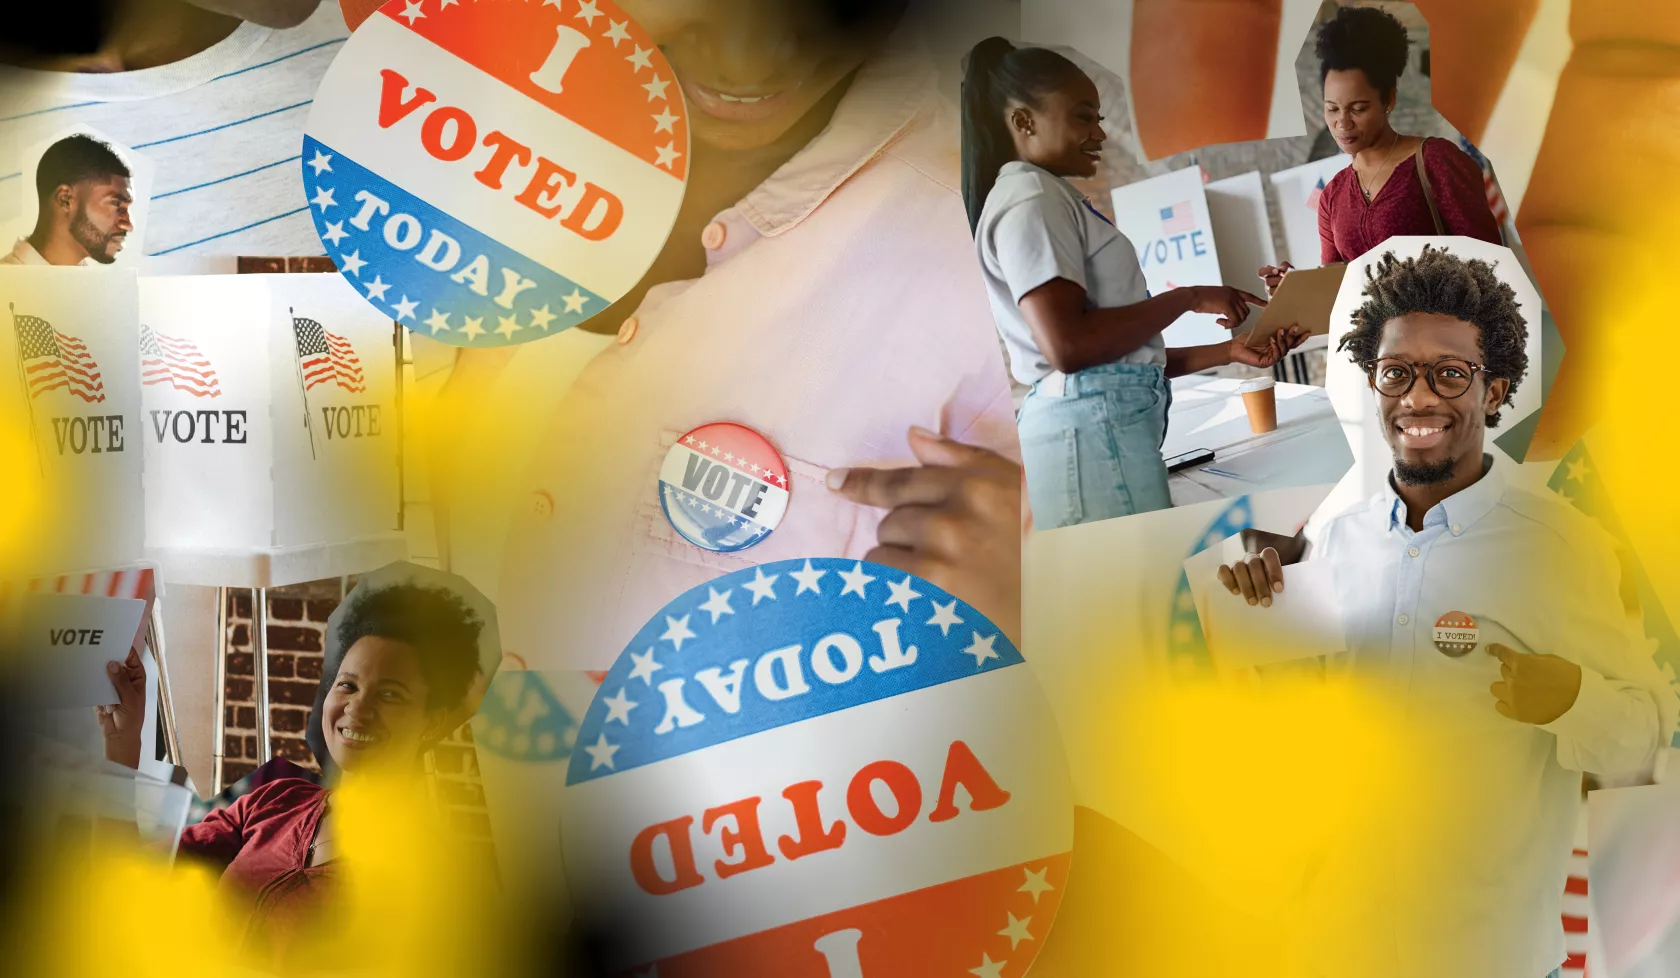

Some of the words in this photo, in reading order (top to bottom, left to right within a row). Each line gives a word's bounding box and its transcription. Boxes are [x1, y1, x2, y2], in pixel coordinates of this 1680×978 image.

[529, 24, 591, 94] I
[377, 68, 625, 241] VOTED
[349, 189, 538, 309] TODAY
[51, 415, 124, 456] VOTE
[149, 410, 248, 444] VOTE
[322, 404, 382, 440] VOTE
[681, 452, 769, 519] VOTE
[50, 628, 104, 646] VOTE
[1436, 631, 1442, 639] I
[1445, 632, 1476, 640] VOTED!
[653, 618, 918, 735] TODAY
[629, 740, 1012, 897] VOTED
